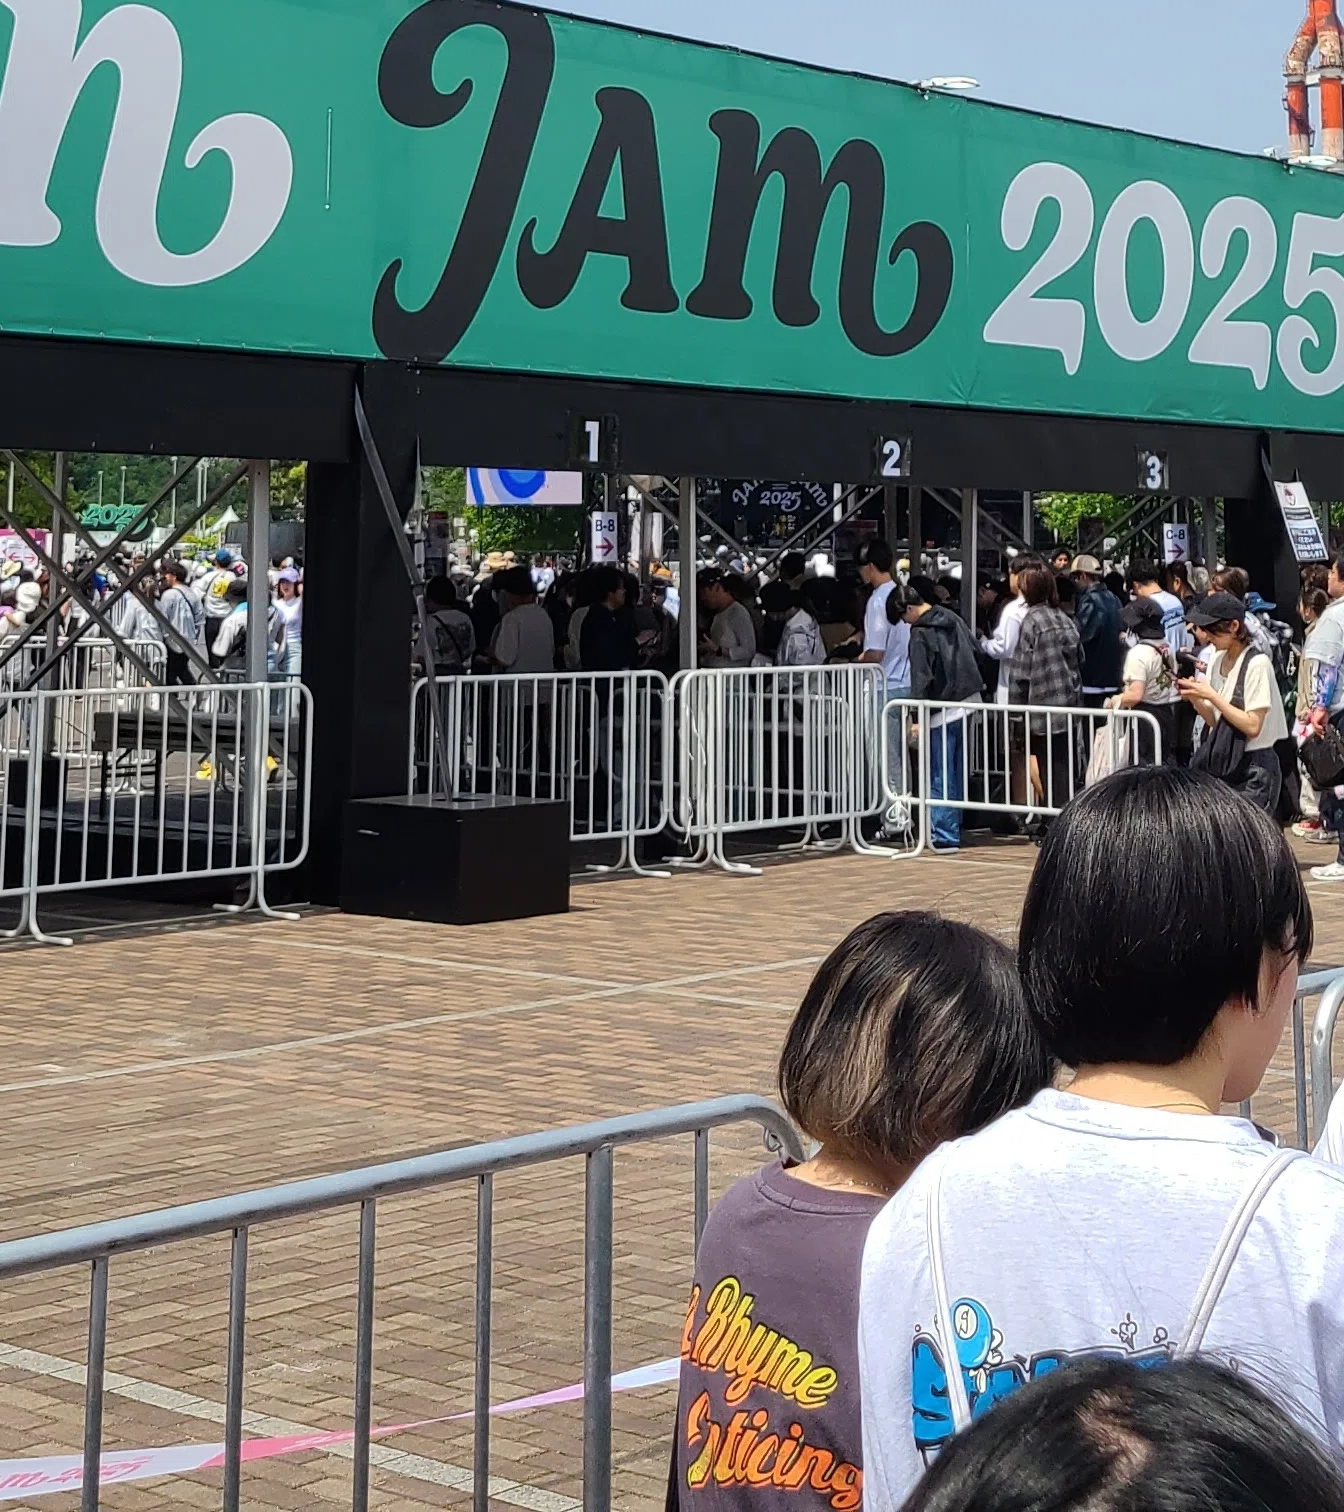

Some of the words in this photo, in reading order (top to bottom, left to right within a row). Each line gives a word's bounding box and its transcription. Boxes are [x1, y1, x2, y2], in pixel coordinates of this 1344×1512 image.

[584, 420, 600, 463] 1
[882, 439, 902, 477] 2
[1146, 455, 1162, 489] 3
[759, 490, 802, 512] 2025
[595, 519, 616, 532] B-8
[1165, 528, 1185, 539] C-8
[690, 1273, 839, 1411] Rhyme
